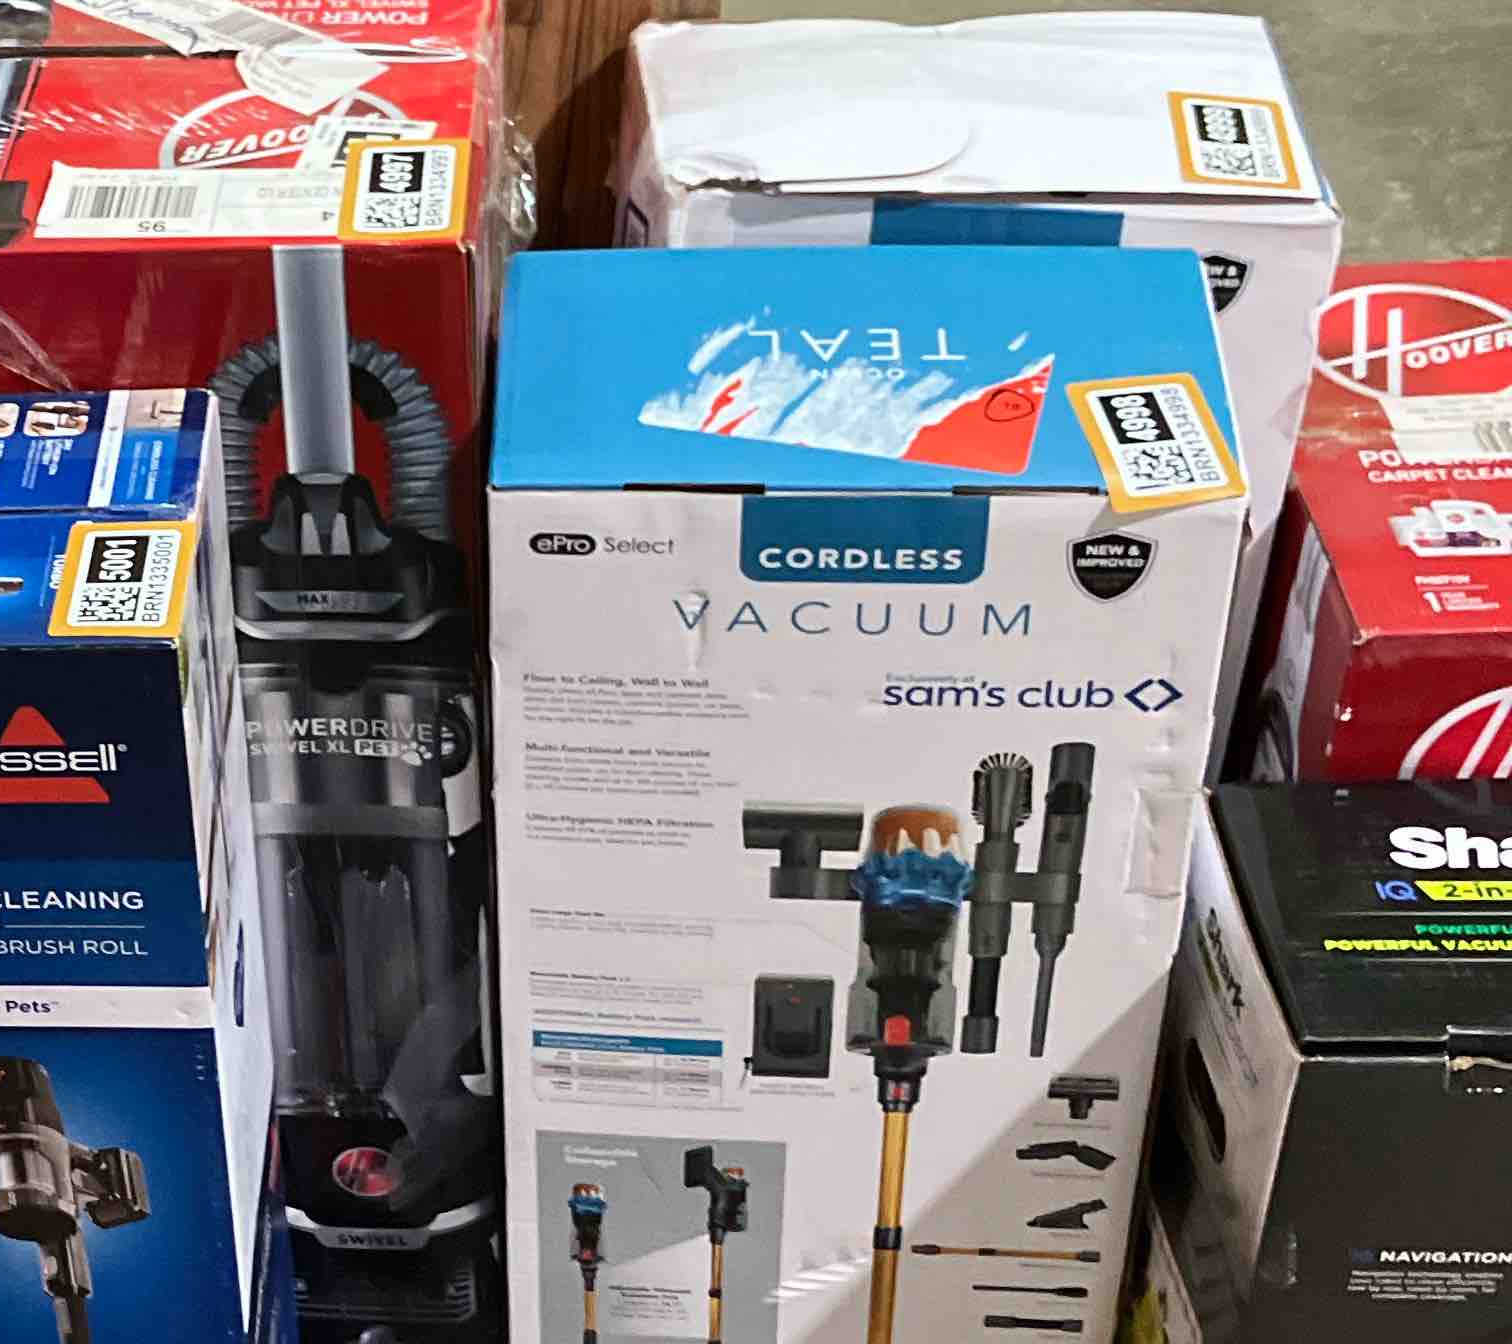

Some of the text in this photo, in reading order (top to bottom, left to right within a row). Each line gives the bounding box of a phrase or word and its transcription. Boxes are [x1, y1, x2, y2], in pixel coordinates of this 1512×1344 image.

[321, 9, 429, 26] POWER
[377, 153, 415, 193] 4997
[747, 327, 968, 361] TEAL
[1109, 394, 1161, 442] 4998
[534, 536, 674, 555] ePro Select
[758, 547, 963, 571] CORDLESS
[1086, 544, 1140, 557] NEW &
[98, 540, 137, 582] 5001
[141, 534, 176, 623] BRN1335001
[672, 599, 1032, 637] VACUUM
[883, 680, 1114, 708] sam's club
[325, 740, 352, 754] XL
[83, 939, 149, 956] ROLL
